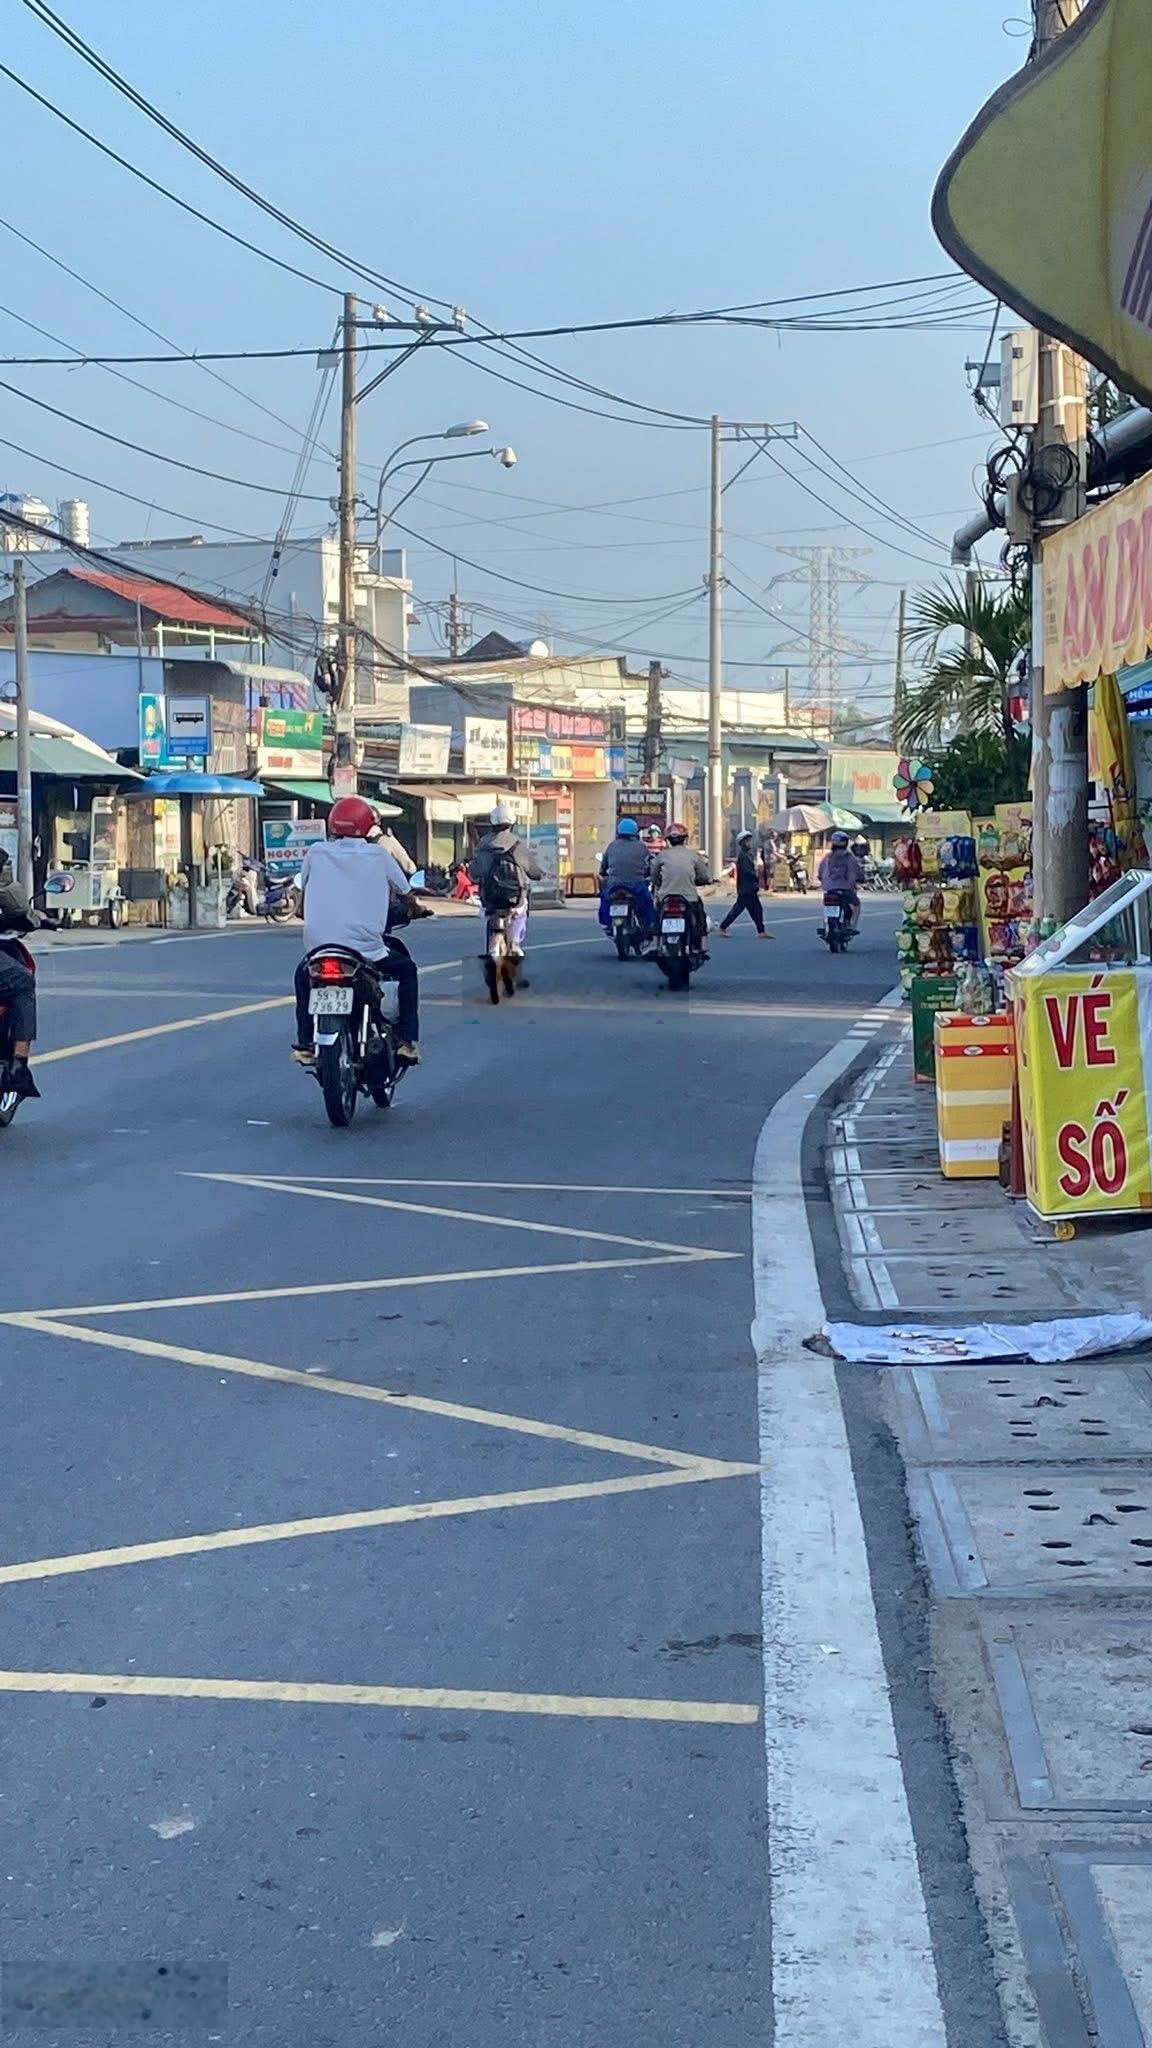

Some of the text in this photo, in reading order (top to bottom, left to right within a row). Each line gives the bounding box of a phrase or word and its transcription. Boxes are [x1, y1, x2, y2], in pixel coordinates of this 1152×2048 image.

[268, 849, 298, 859] NGỌC
[1045, 974, 1116, 1069] VÉ
[1059, 1091, 1128, 1197] SỐ
